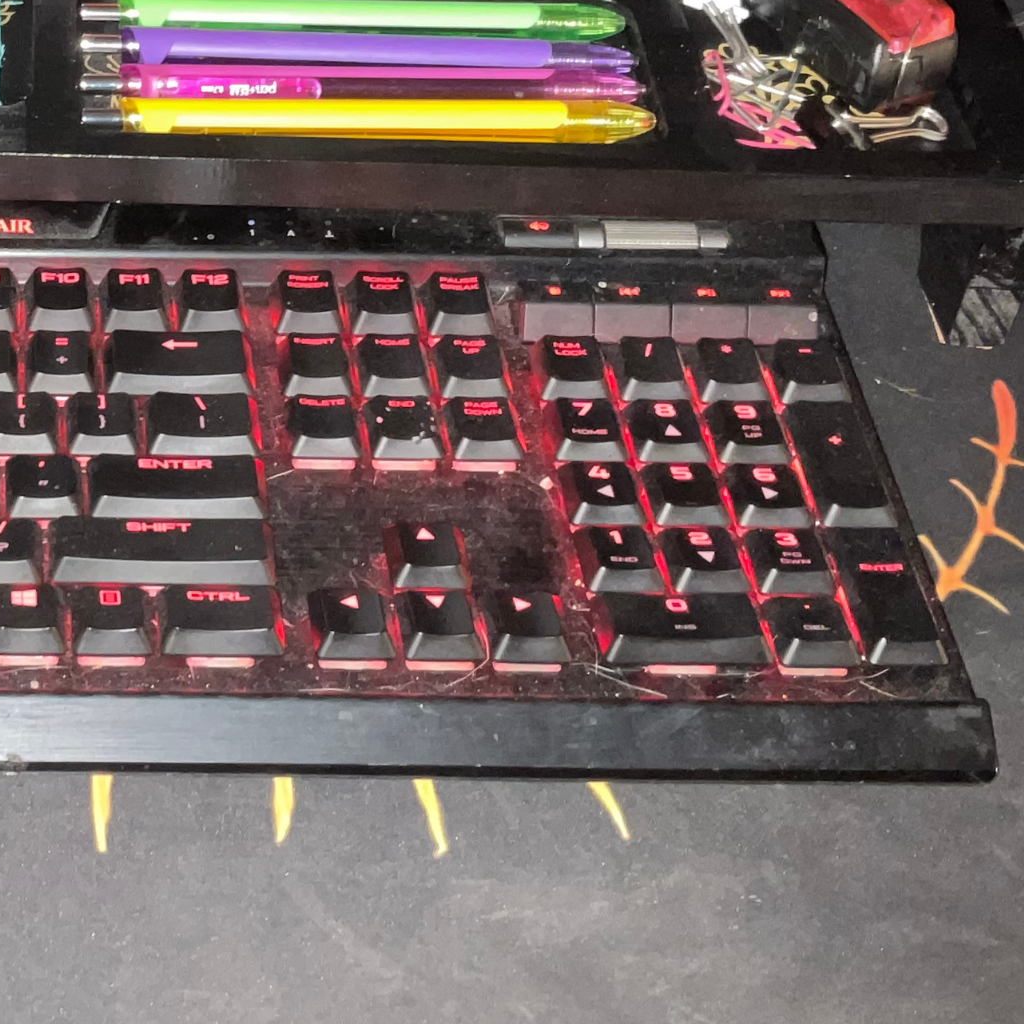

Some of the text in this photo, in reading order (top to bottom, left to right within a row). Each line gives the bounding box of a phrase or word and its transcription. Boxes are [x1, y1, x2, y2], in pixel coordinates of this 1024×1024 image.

[40, 271, 81, 284] F10
[118, 273, 151, 286] F11
[190, 273, 230, 286] F12
[571, 401, 593, 417] 7
[653, 402, 677, 418] 8
[733, 403, 758, 420] 9
[571, 427, 609, 435] HOME
[137, 457, 213, 470] ENTER
[587, 464, 611, 480] 4
[669, 465, 694, 481] 5
[751, 466, 777, 483] 6
[125, 520, 192, 533] SHIFT
[608, 529, 623, 545] 1
[687, 531, 713, 547] 2
[774, 531, 799, 548] 3
[185, 590, 251, 602] CTRL
[664, 598, 689, 613] 0
